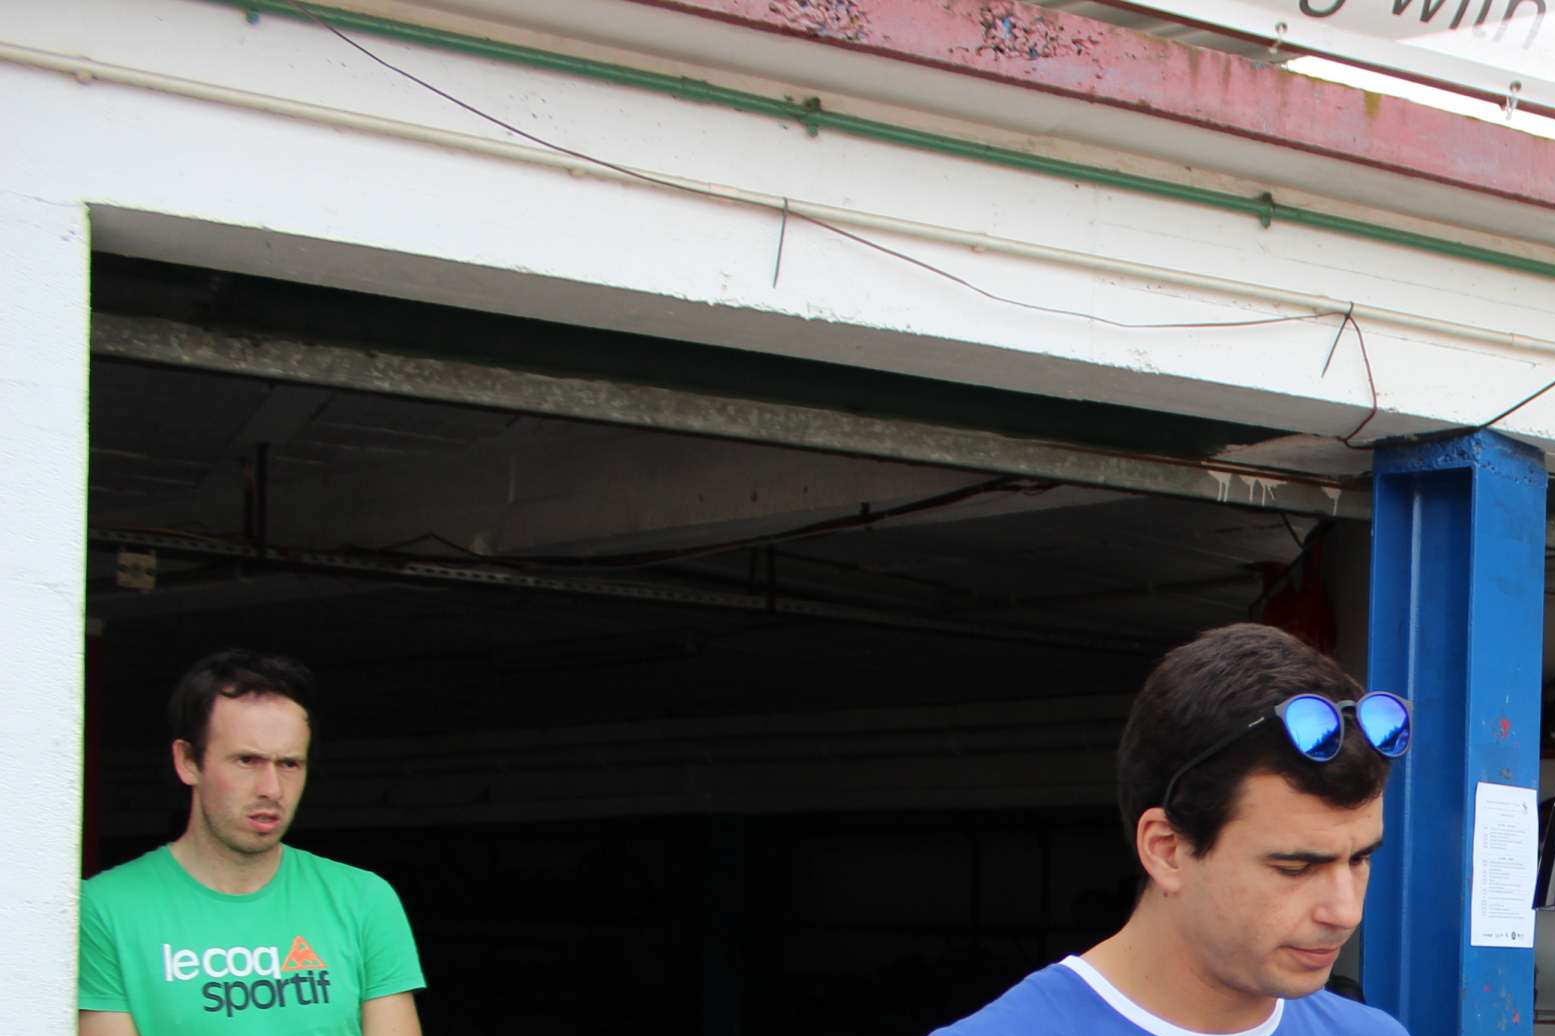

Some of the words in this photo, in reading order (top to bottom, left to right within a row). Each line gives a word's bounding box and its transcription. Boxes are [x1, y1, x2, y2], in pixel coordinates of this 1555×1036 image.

[163, 943, 200, 982] le
[202, 946, 280, 980] coq
[202, 970, 332, 1017] sportif
